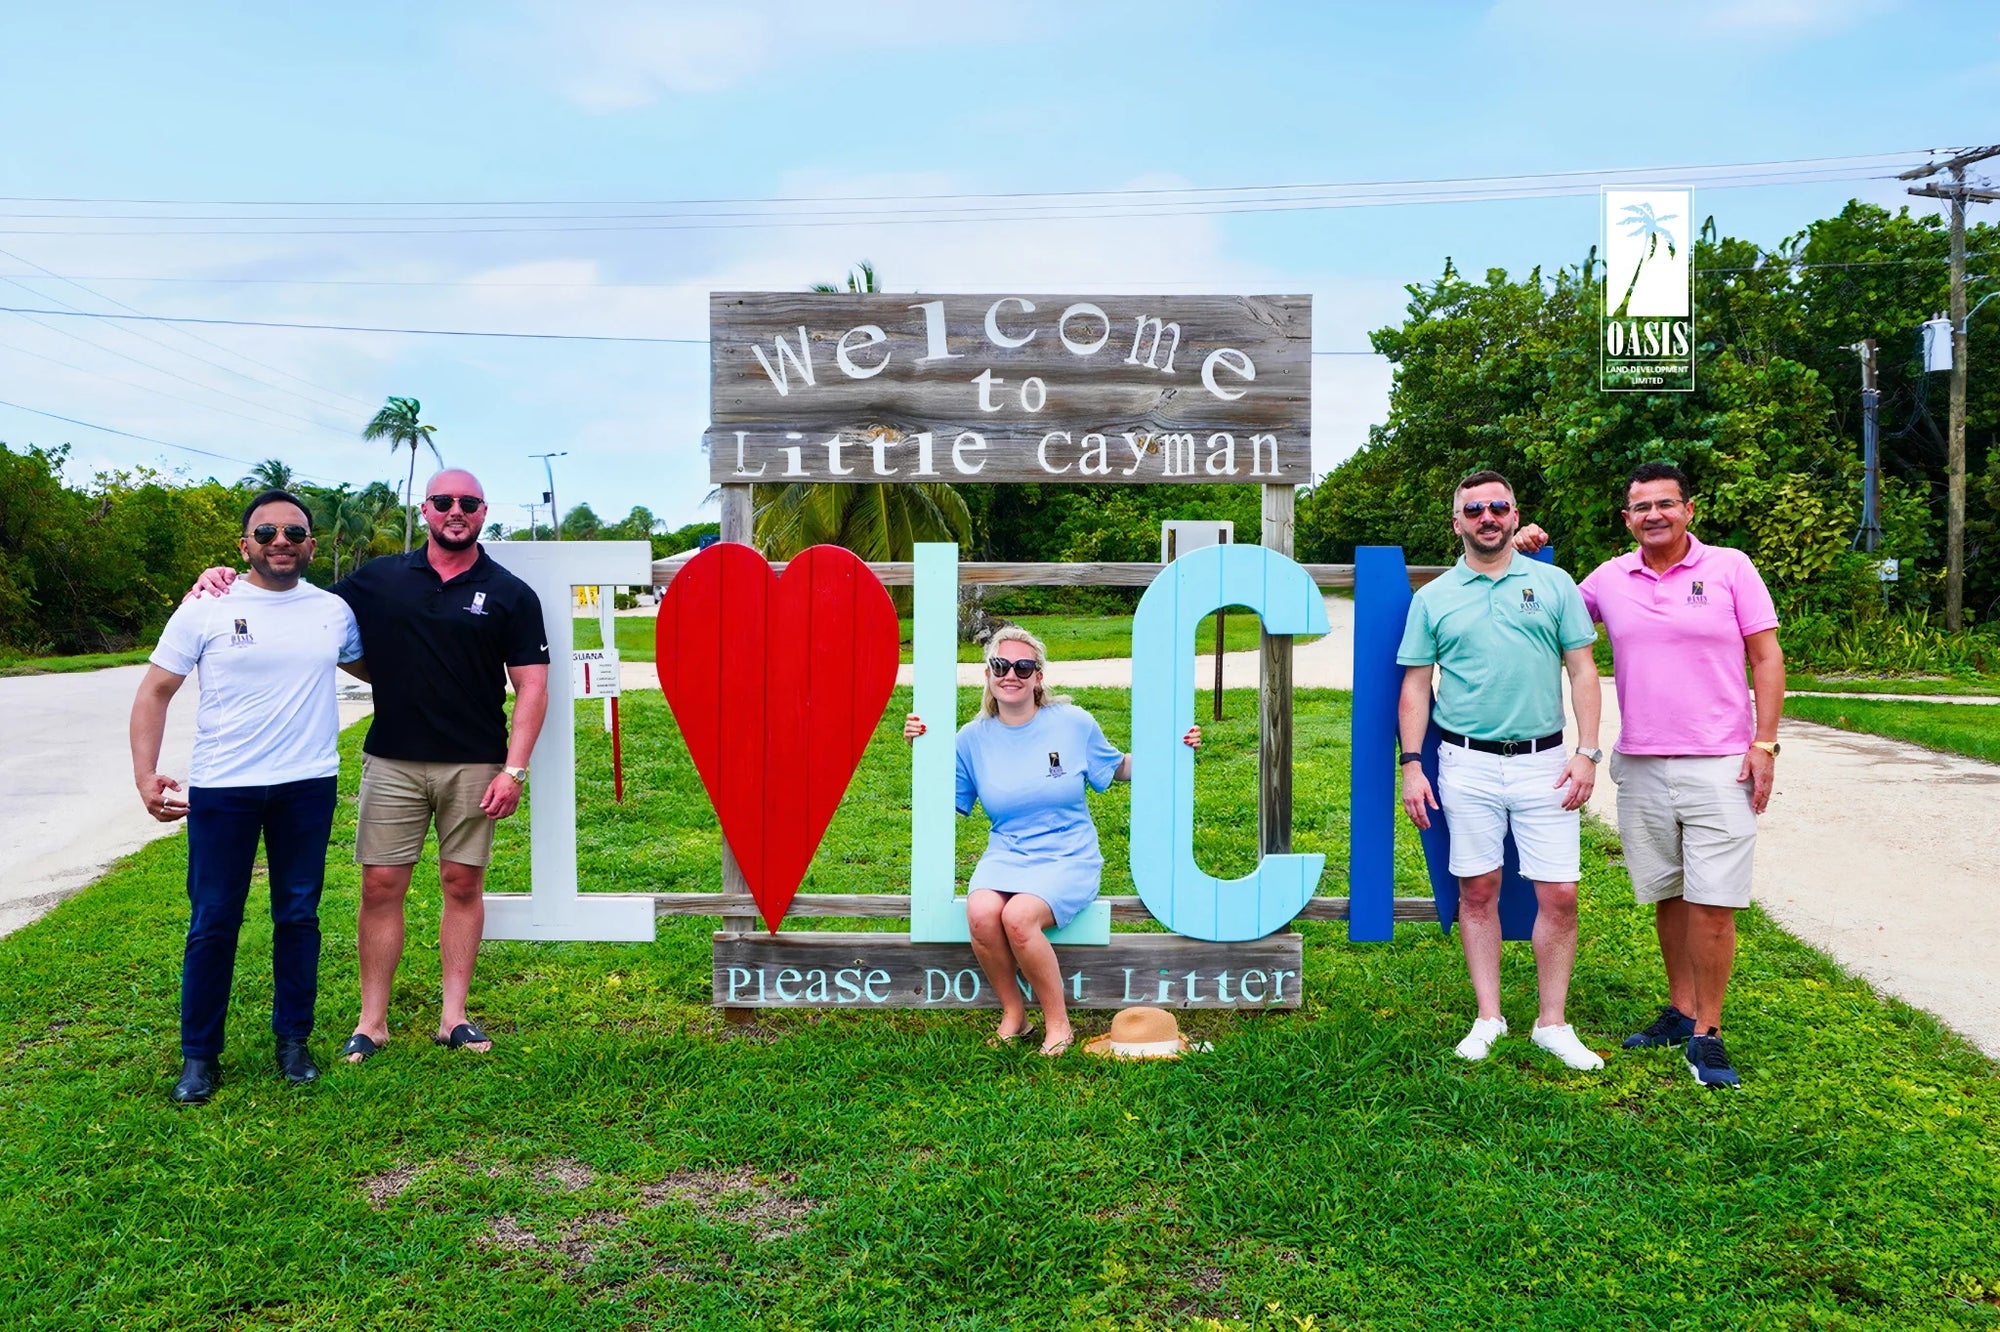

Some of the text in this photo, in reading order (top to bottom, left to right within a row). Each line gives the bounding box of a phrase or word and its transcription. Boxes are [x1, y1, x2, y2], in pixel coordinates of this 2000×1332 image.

[750, 297, 1256, 400] Welcome
[969, 368, 1047, 413] to
[731, 430, 988, 477] Little
[726, 966, 893, 1002] Please
[1121, 967, 1297, 1003] Litter
